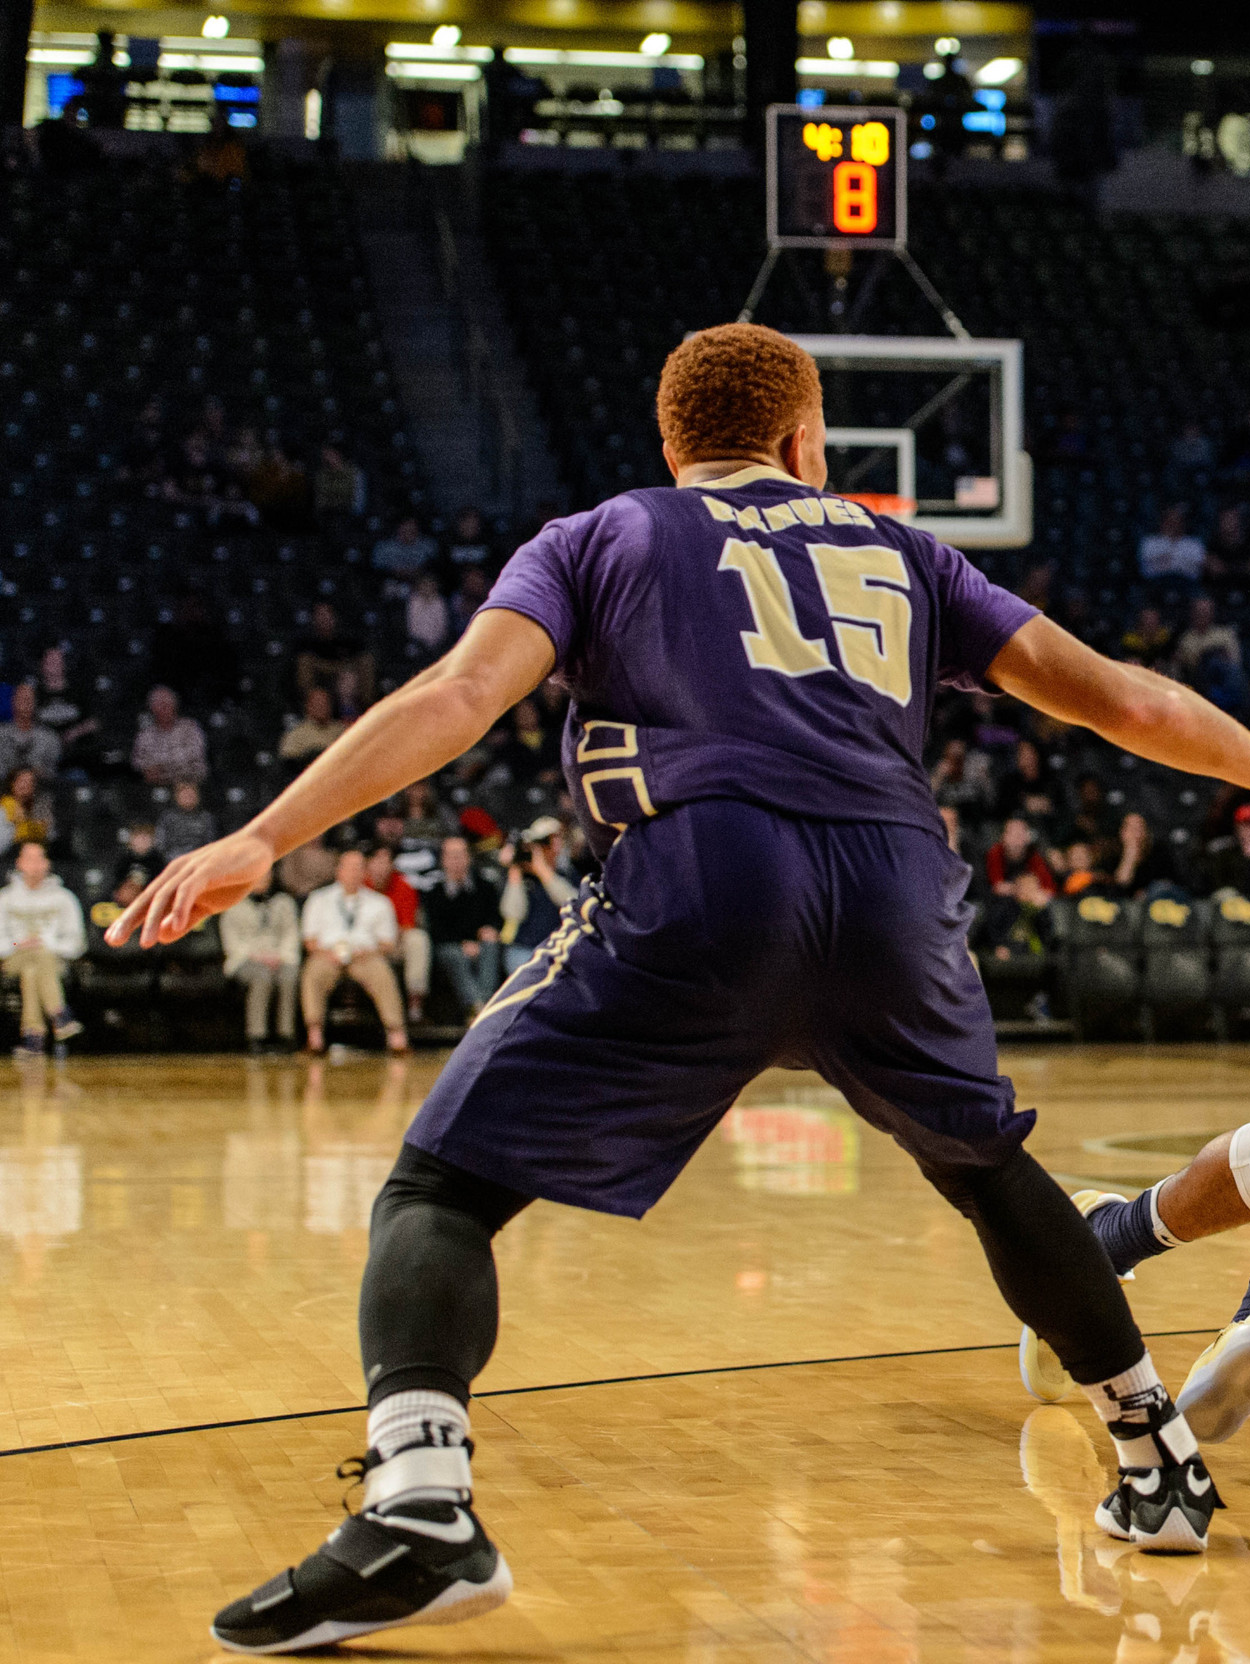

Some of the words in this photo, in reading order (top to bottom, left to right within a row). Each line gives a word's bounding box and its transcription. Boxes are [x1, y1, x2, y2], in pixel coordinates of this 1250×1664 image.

[802, 122, 889, 166] 4:10
[833, 160, 877, 233] 8
[716, 537, 912, 708] 15
